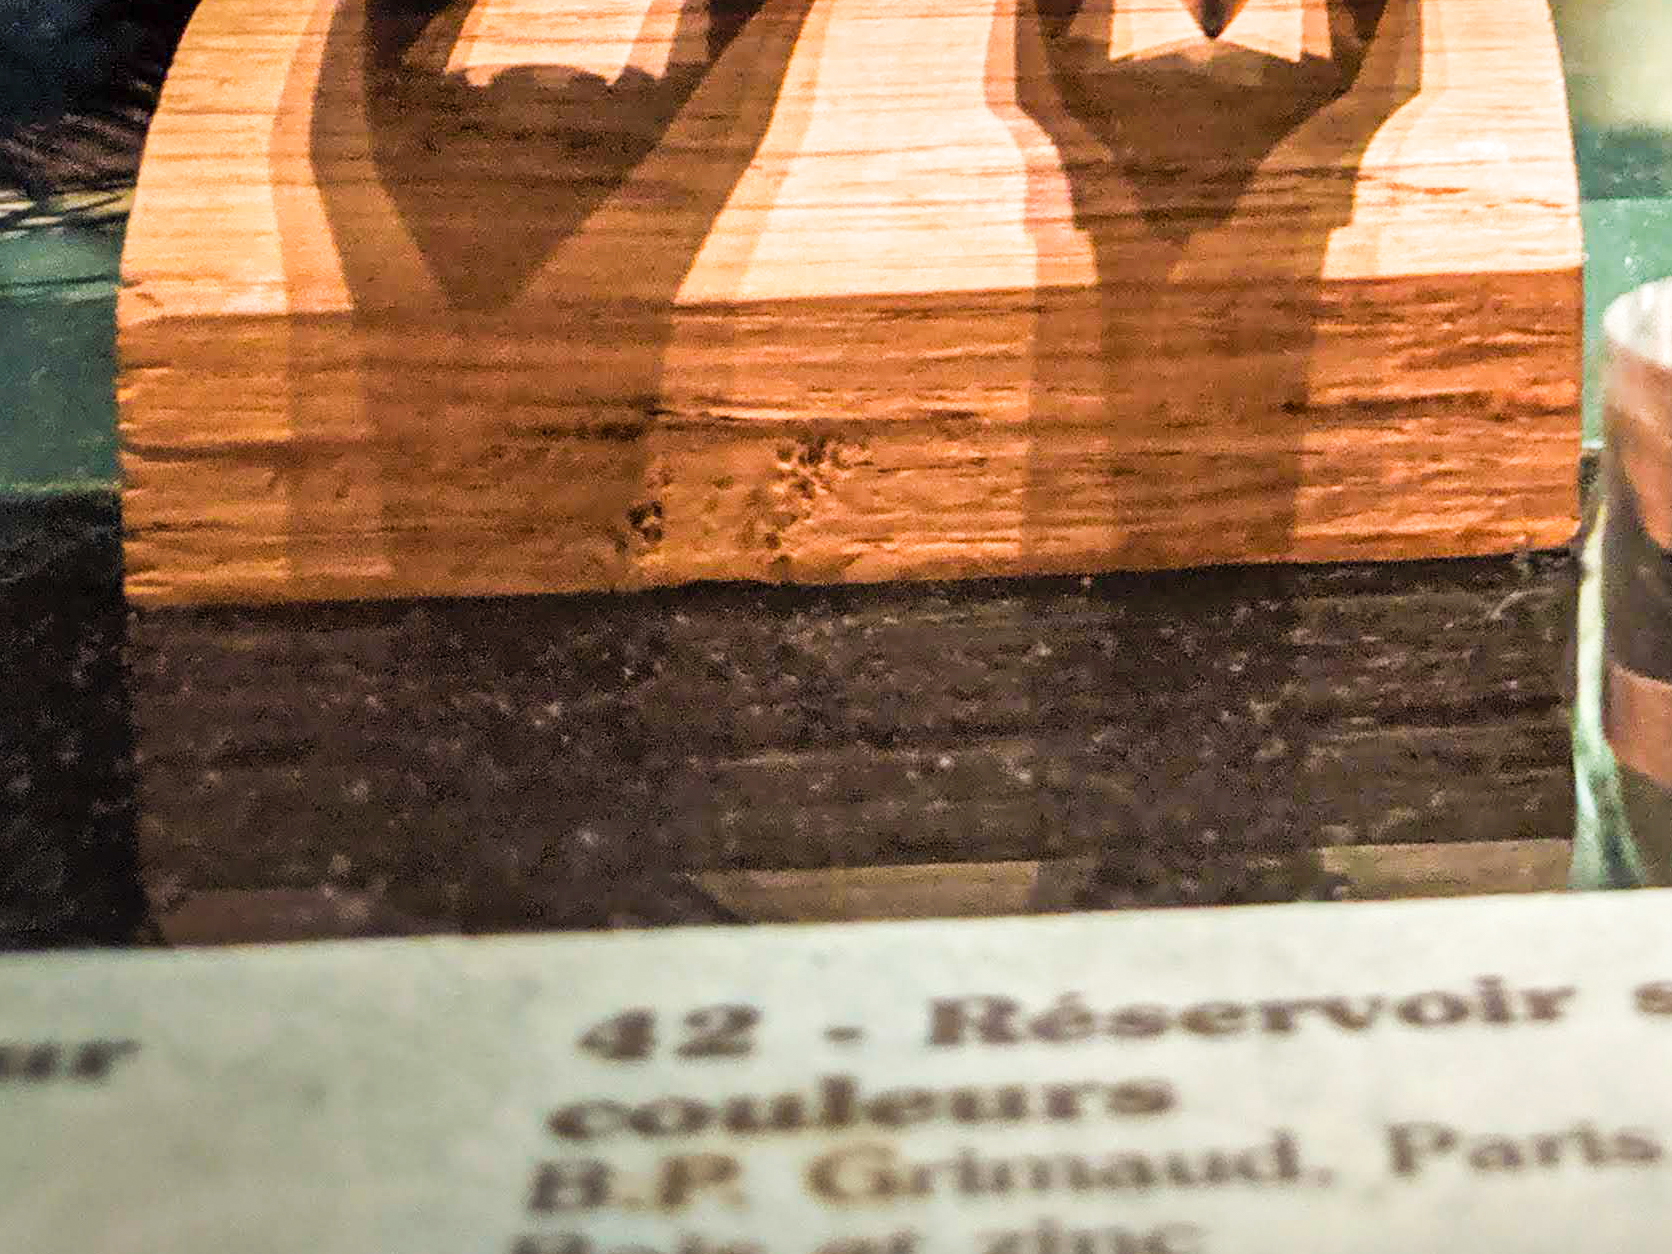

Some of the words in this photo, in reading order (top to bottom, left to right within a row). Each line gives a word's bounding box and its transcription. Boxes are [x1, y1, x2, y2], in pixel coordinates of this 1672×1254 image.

[577, 1003, 765, 1061] 42
[926, 974, 1577, 1047] Réservoir
[546, 1074, 1182, 1142] couleurs
